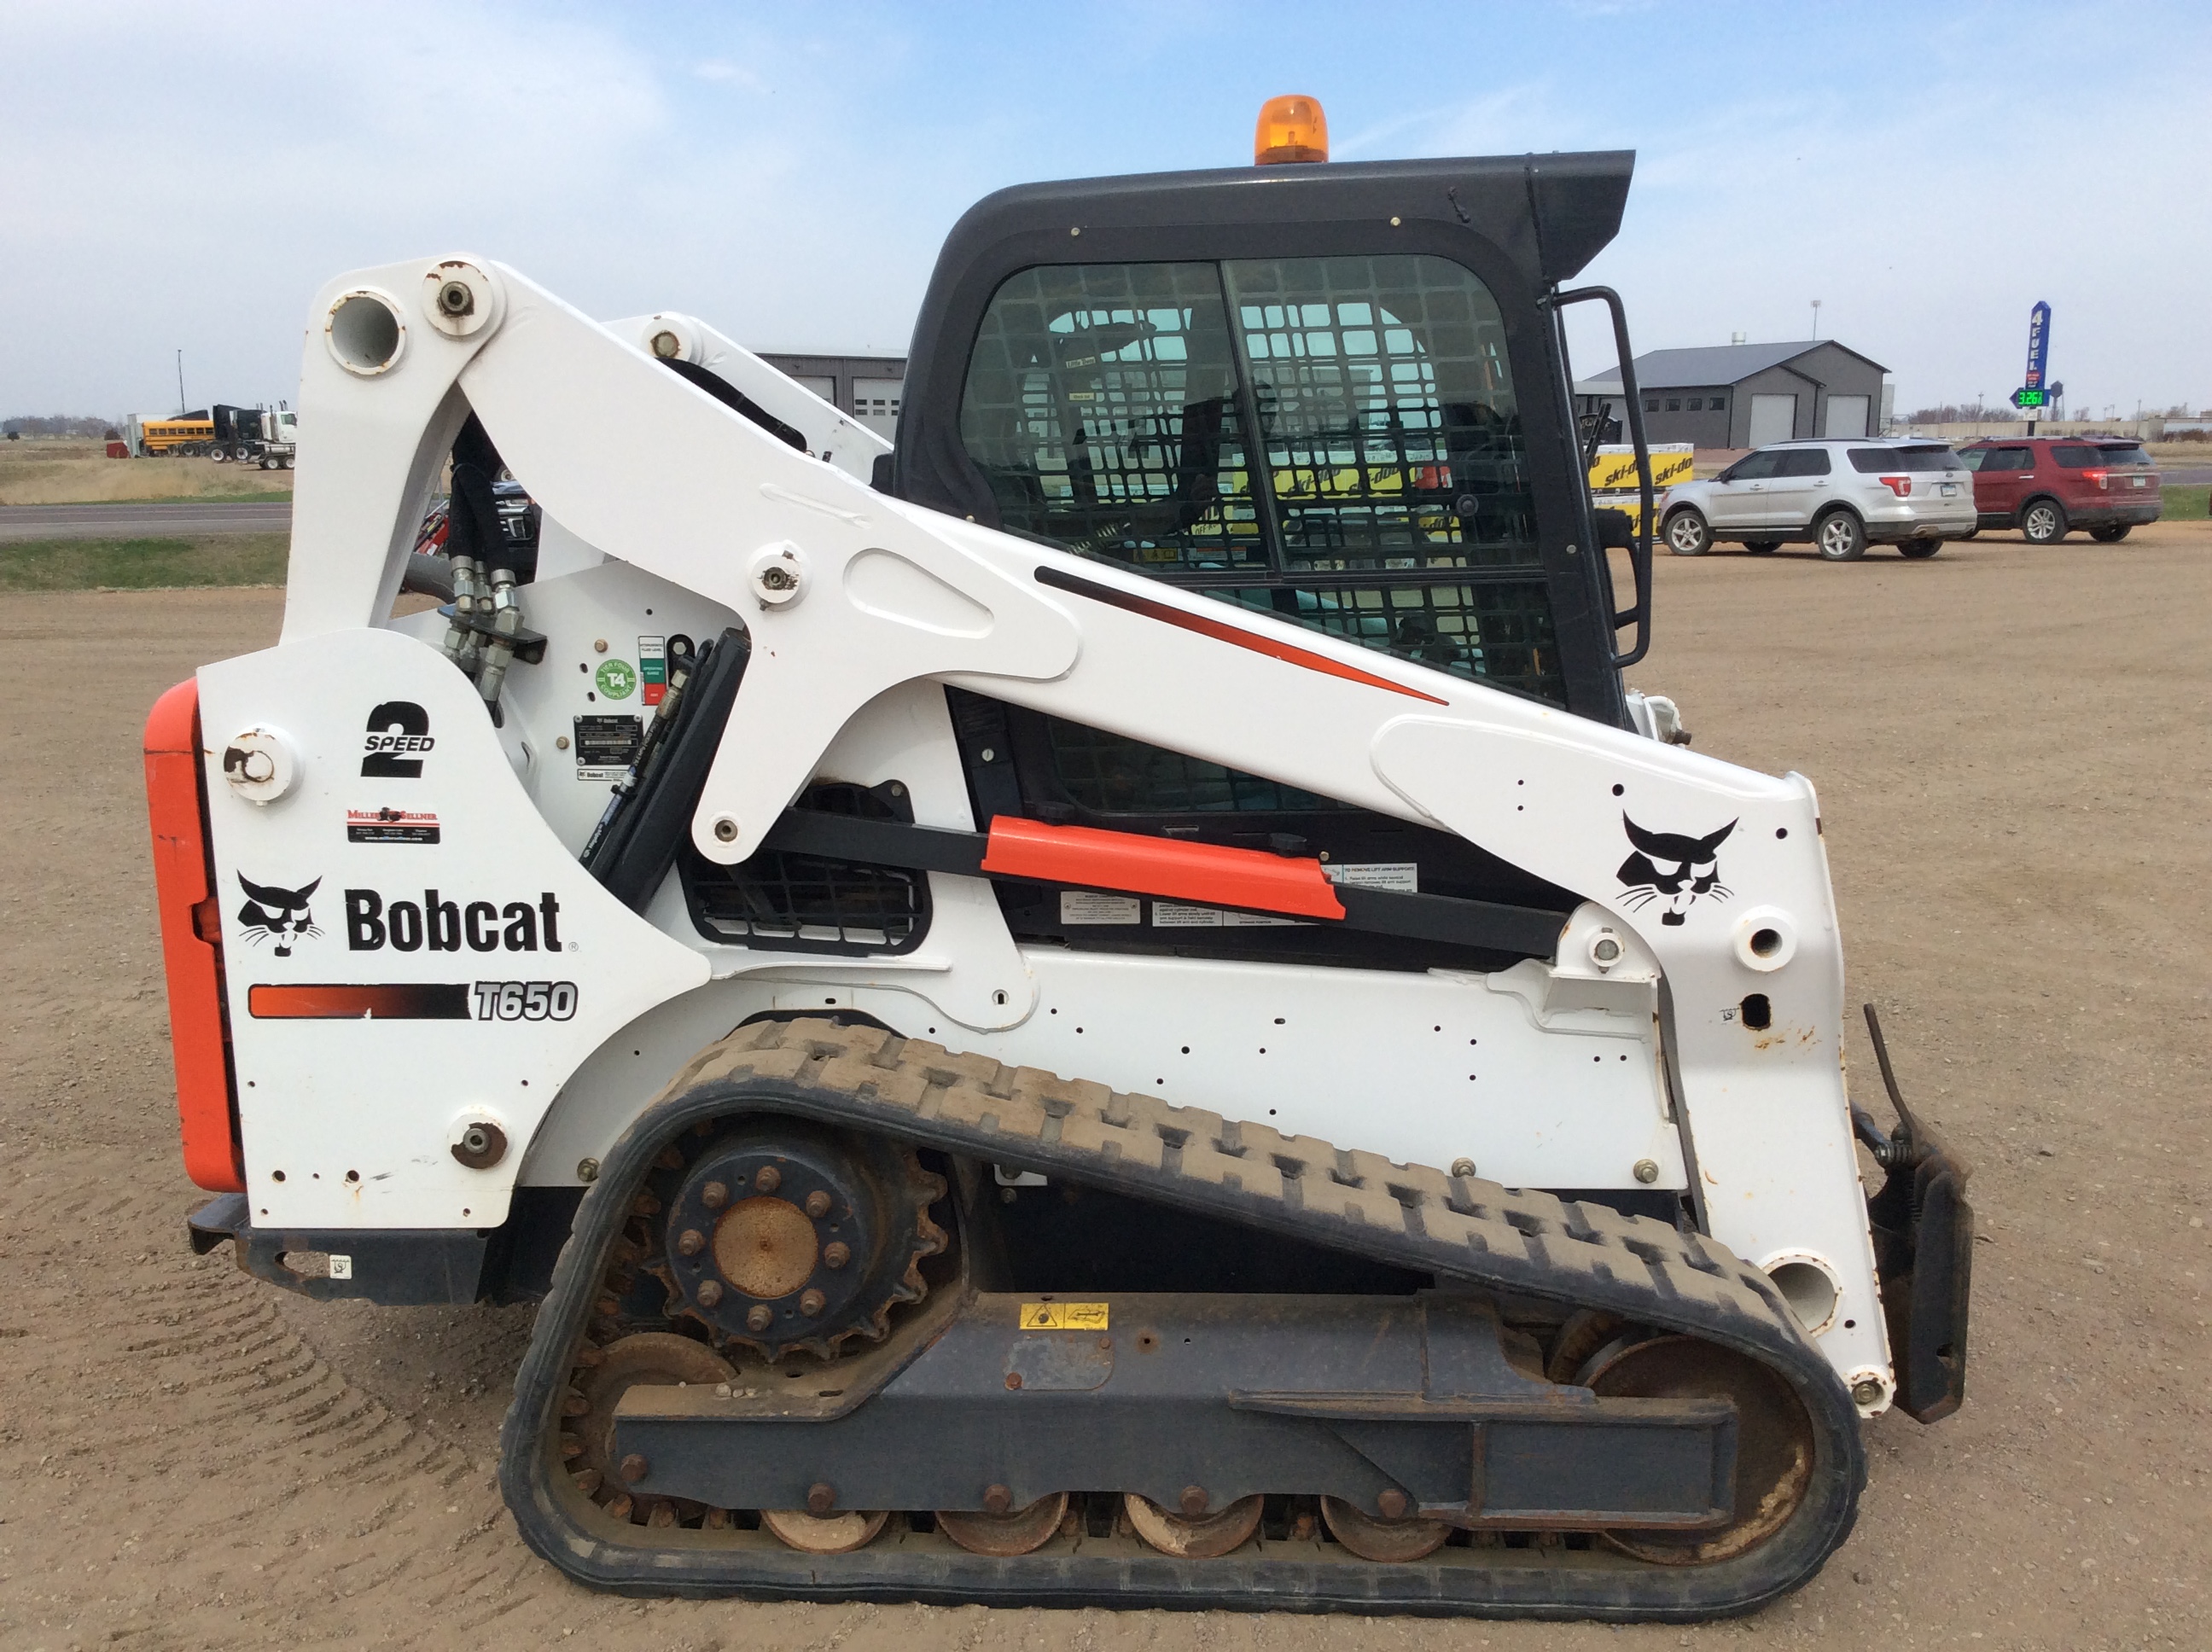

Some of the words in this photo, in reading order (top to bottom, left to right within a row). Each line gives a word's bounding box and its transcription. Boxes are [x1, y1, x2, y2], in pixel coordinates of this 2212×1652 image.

[2032, 310, 2043, 326] 4
[2029, 327, 2041, 370] FUEL
[601, 663, 614, 673] TIER
[614, 662, 631, 673] FOUR
[607, 672, 626, 688] T4
[360, 701, 429, 778] 2
[364, 736, 435, 753] SPEED
[345, 888, 562, 952] Bobcat
[474, 981, 579, 1022] T650
